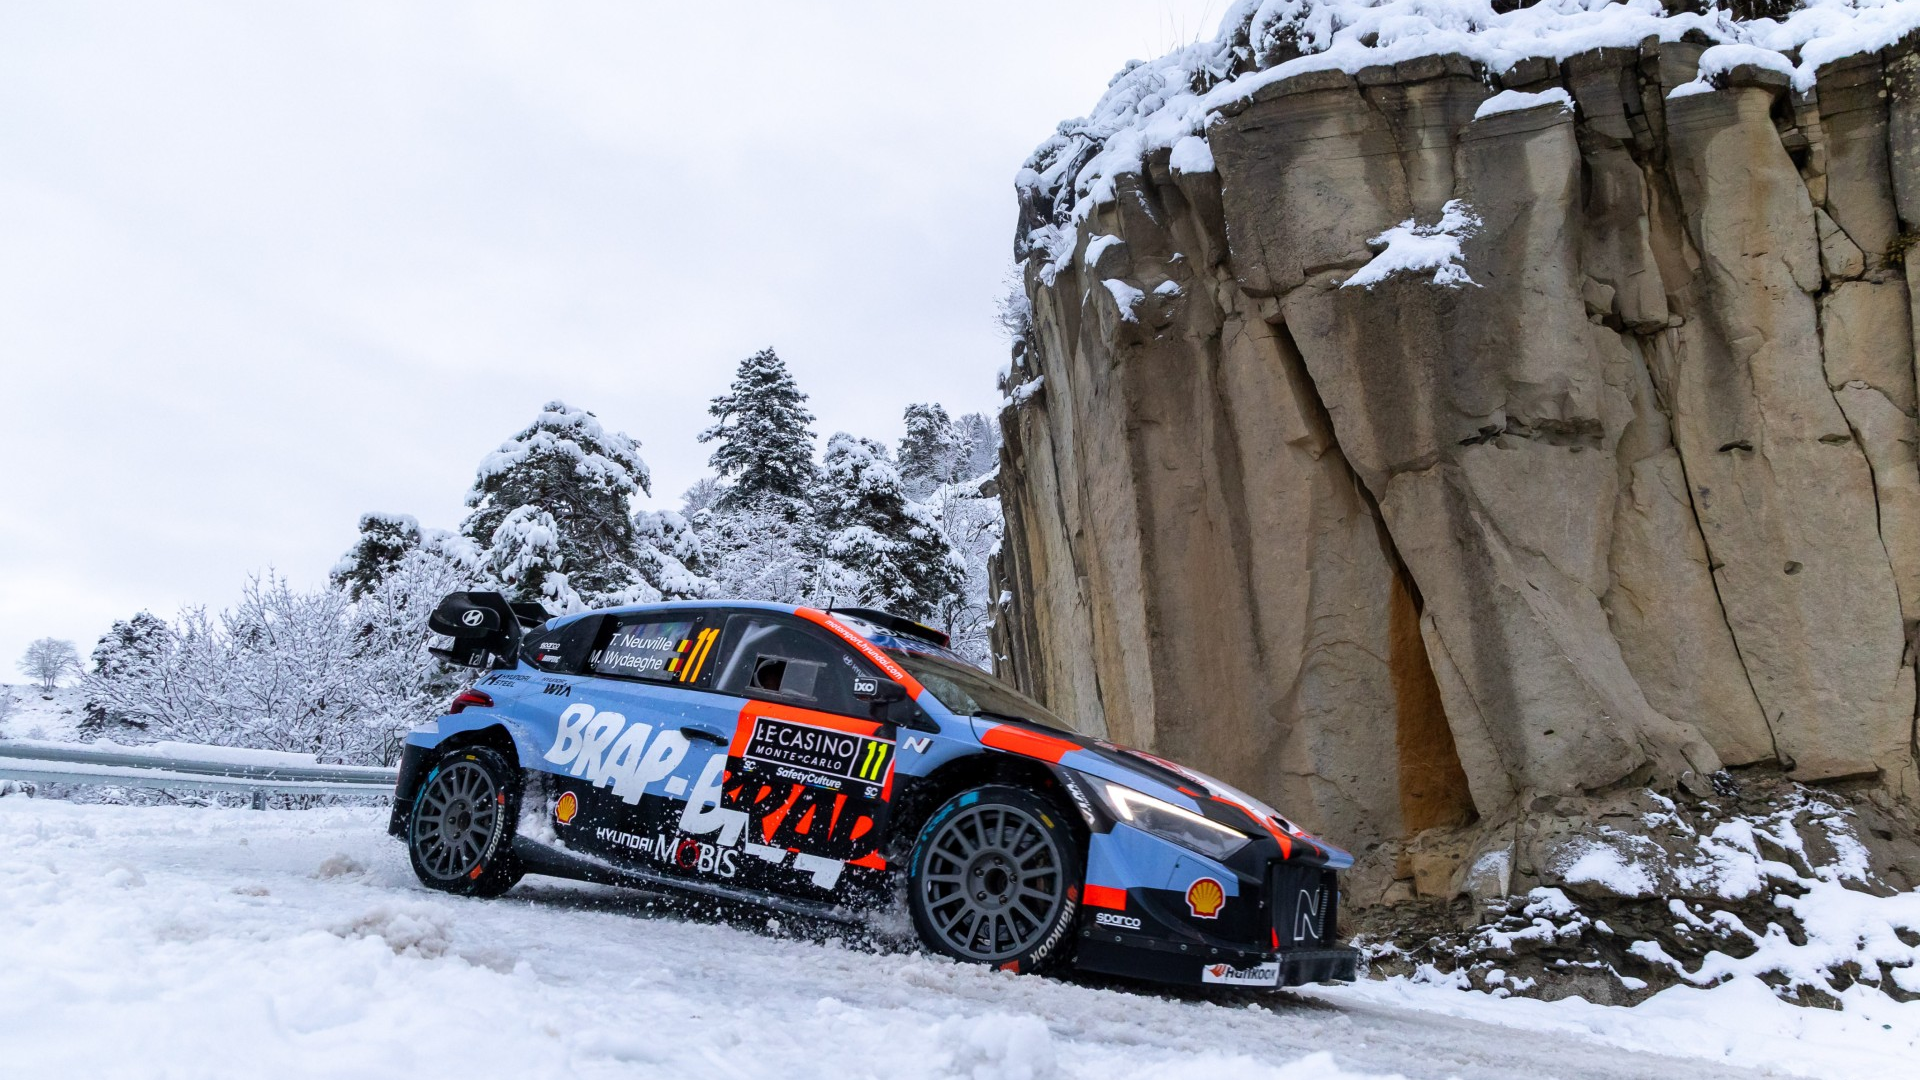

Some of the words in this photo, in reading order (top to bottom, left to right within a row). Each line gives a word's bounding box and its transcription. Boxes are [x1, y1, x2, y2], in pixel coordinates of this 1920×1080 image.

[609, 633, 621, 647] T.
[623, 634, 674, 652] Neuville
[824, 620, 904, 680] motorsport.hyundai.com
[588, 649, 600, 664] M.
[603, 651, 663, 672] Wydaeghe
[680, 627, 721, 683] 11
[493, 680, 516, 688] STEEL
[500, 673, 532, 682] HYUNDAI
[778, 727, 855, 758] CASINO
[743, 759, 757, 771] SC
[859, 740, 889, 782] 11
[775, 766, 842, 790] SafetyCulture
[864, 785, 879, 797] SC
[596, 826, 654, 853] HYUNDAI
[654, 833, 738, 878] MOBIS
[1096, 912, 1142, 930] sparco
